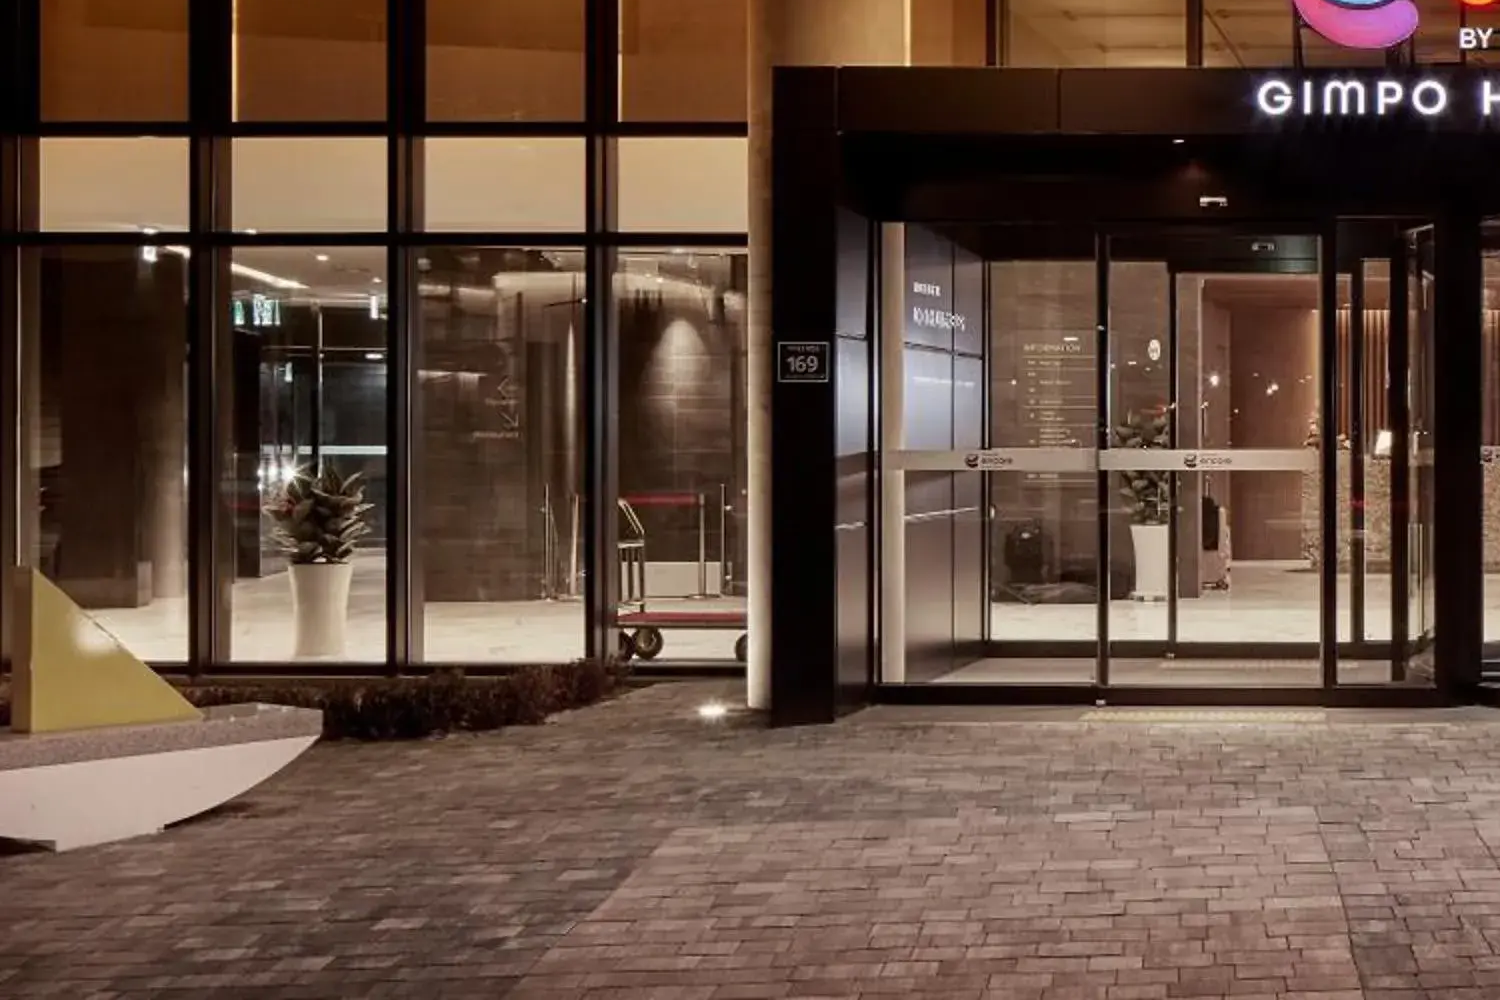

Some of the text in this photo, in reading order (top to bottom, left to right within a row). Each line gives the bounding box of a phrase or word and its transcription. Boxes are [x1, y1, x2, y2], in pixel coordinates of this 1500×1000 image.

[1458, 27, 1493, 50] BY
[1256, 78, 1448, 117] GIMPO
[785, 355, 819, 373] 169
